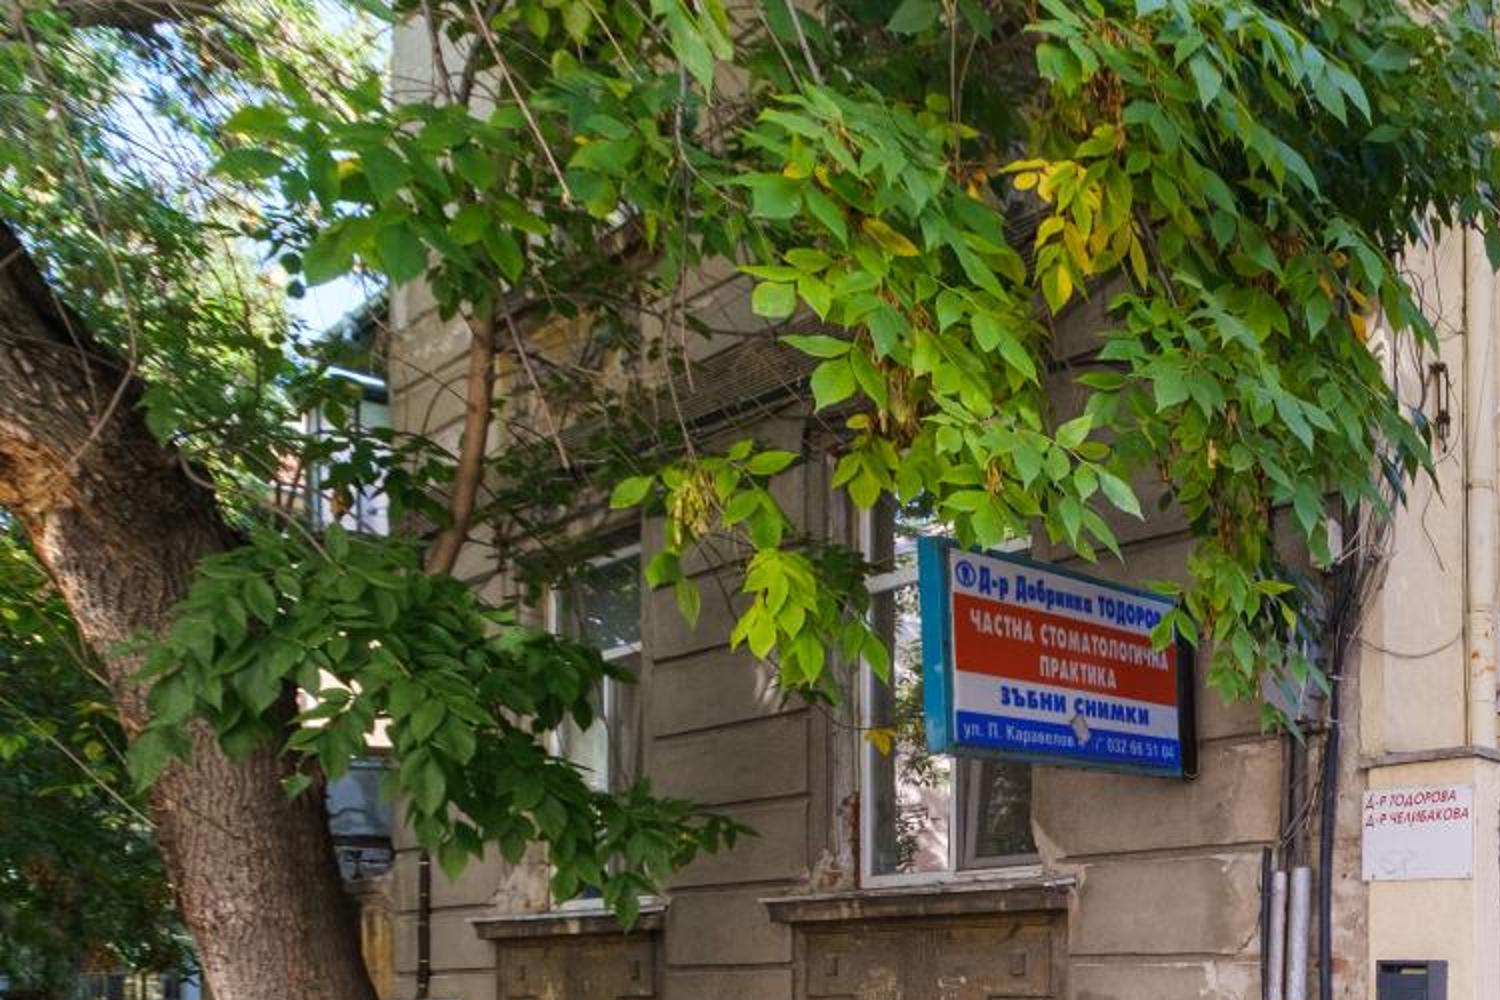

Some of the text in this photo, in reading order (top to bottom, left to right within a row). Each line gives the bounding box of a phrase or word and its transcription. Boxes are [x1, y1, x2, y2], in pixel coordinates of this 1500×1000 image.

[978, 566, 1009, 600] Д-р
[970, 608, 1168, 671] ЧАСТНА СТОМАТОЛОГИЧНА
[1039, 655, 1117, 689] ПРАКТИКА
[1000, 686, 1150, 727] ЗЪБНИ СНИМКИ
[963, 722, 984, 738] ул.
[1006, 725, 1075, 748] Каравелов
[1388, 789, 1457, 808] ТОДОРОВА
[1389, 807, 1469, 824] ЧЕЛИБАКОВА
